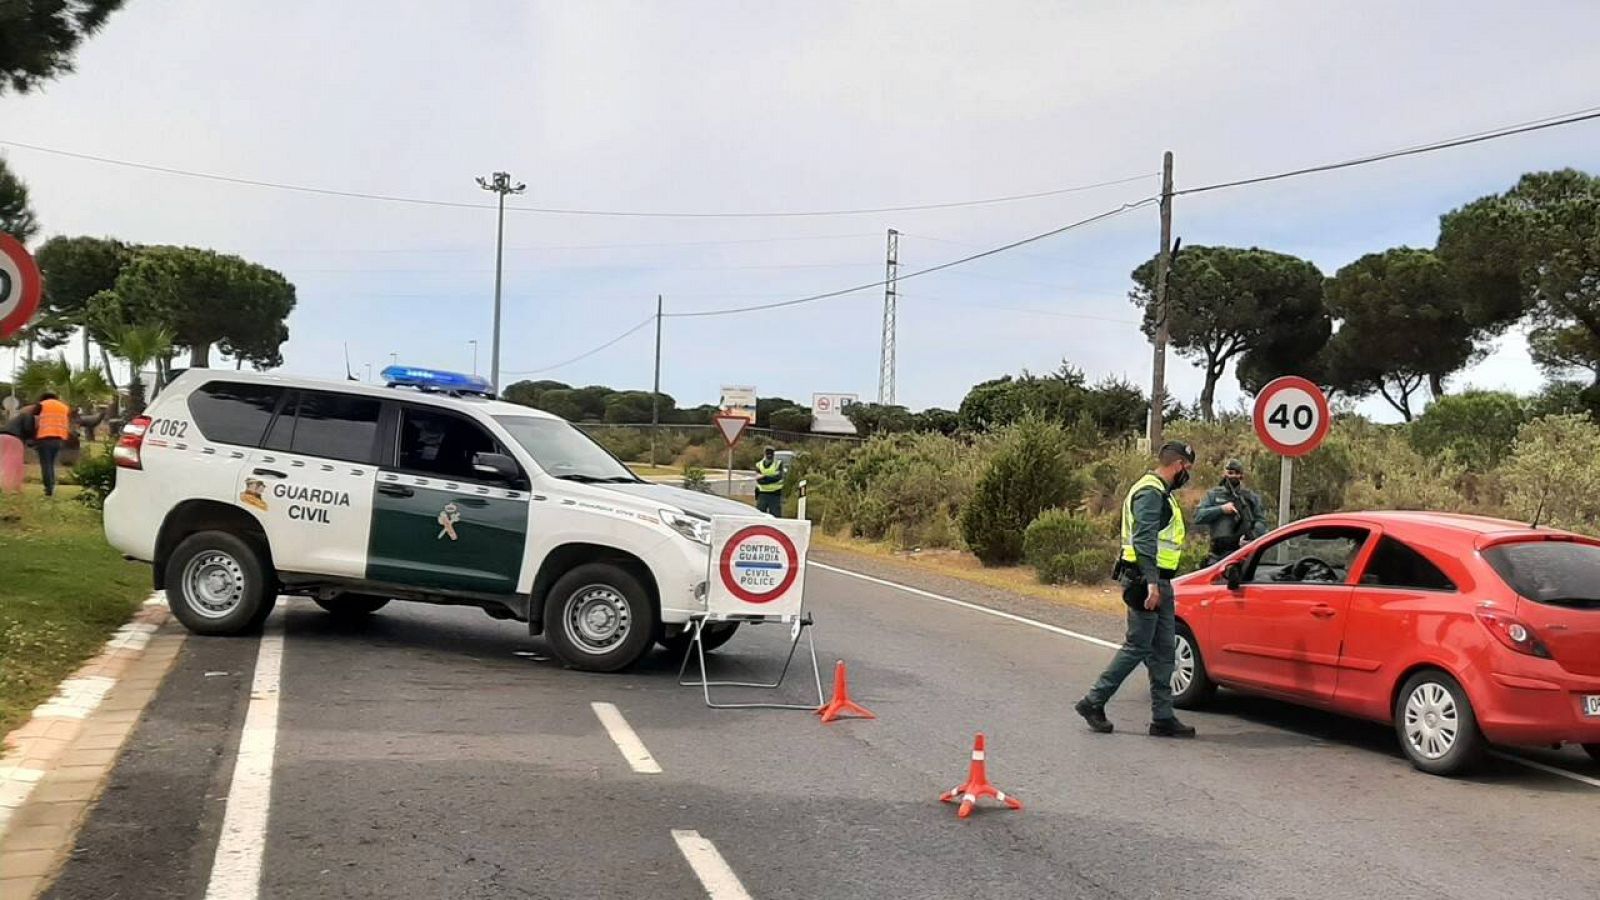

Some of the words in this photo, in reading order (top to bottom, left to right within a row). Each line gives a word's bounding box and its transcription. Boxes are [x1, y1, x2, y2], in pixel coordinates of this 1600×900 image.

[1268, 404, 1313, 430] 40
[160, 419, 188, 438] 062
[273, 484, 350, 506] GUARDIA
[288, 505, 330, 524] CIVIL
[740, 544, 780, 553] CONTROL
[740, 576, 775, 585] POLICE
[745, 569, 770, 577] CIVIL
